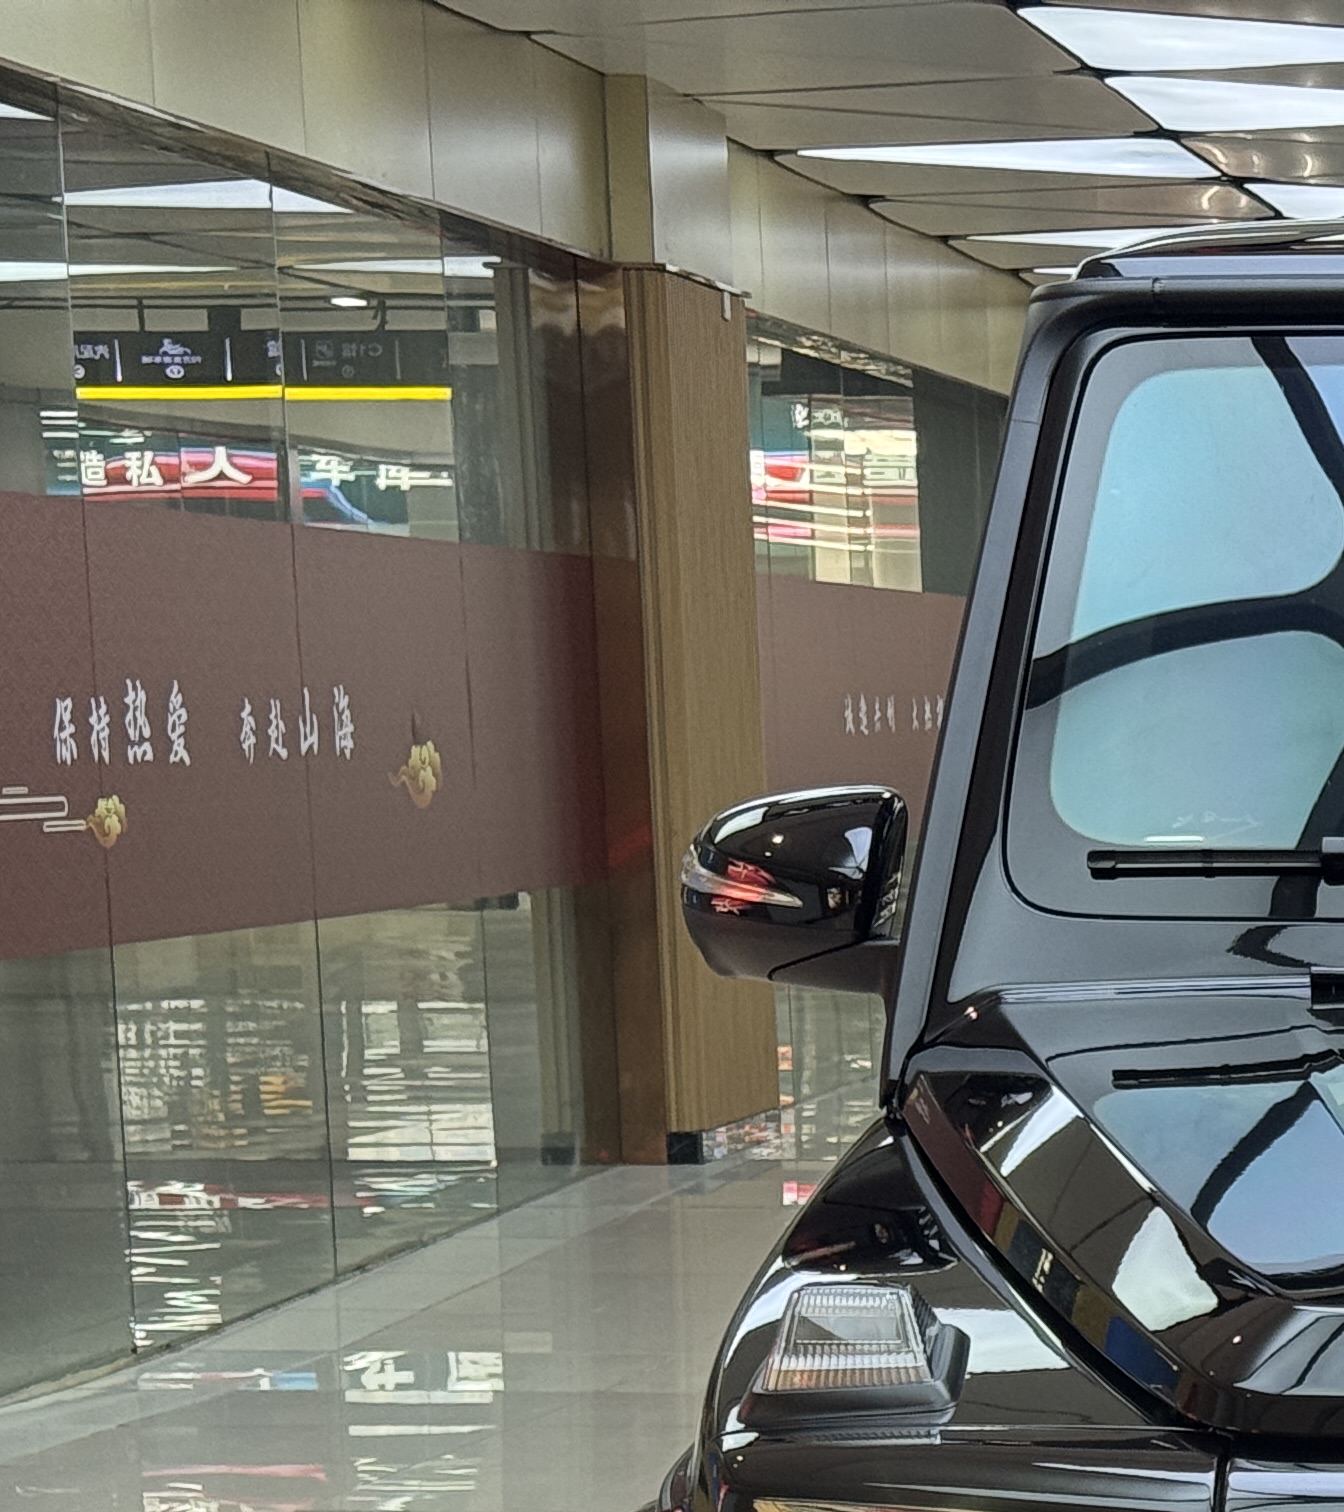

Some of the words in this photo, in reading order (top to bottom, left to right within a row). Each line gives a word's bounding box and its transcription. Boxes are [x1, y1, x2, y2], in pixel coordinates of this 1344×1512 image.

[54, 678, 190, 766] 保持热爱
[240, 684, 354, 765] 奔赴山海
